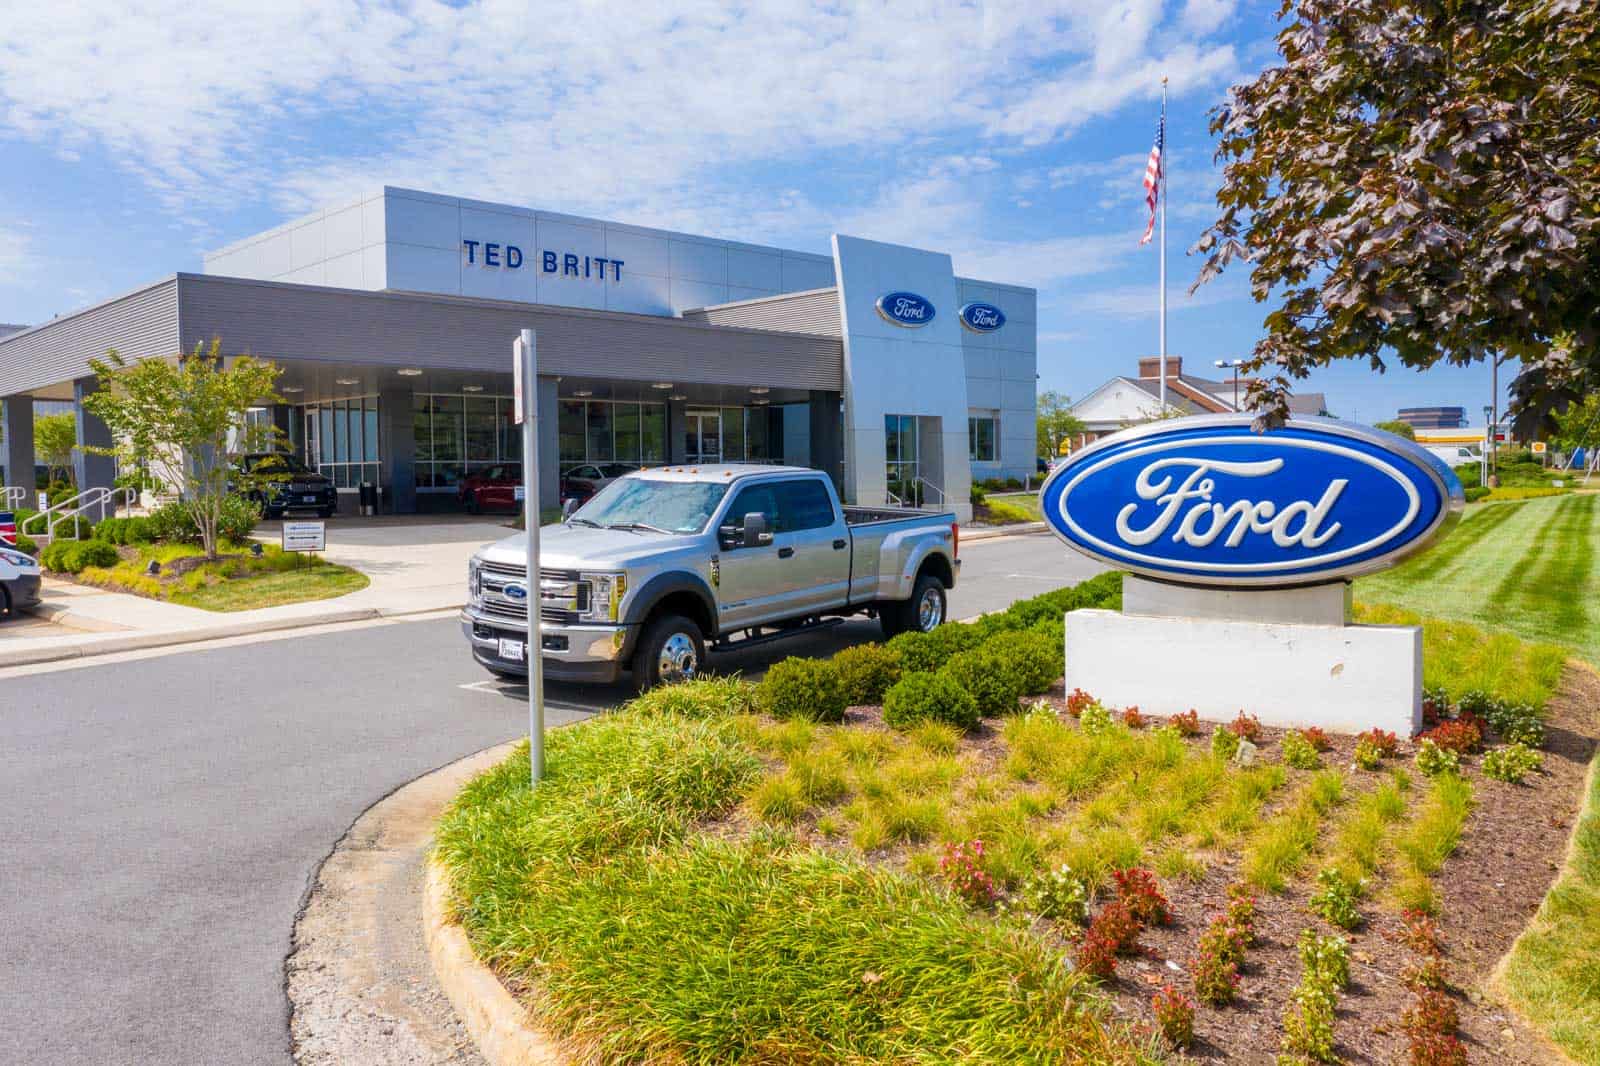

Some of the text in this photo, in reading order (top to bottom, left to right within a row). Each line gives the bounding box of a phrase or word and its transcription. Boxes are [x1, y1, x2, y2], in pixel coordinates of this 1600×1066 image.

[464, 240, 624, 281] TED BRITT
[894, 298, 925, 319] Ford
[973, 308, 999, 327] Ford
[1116, 457, 1348, 547] Ford
